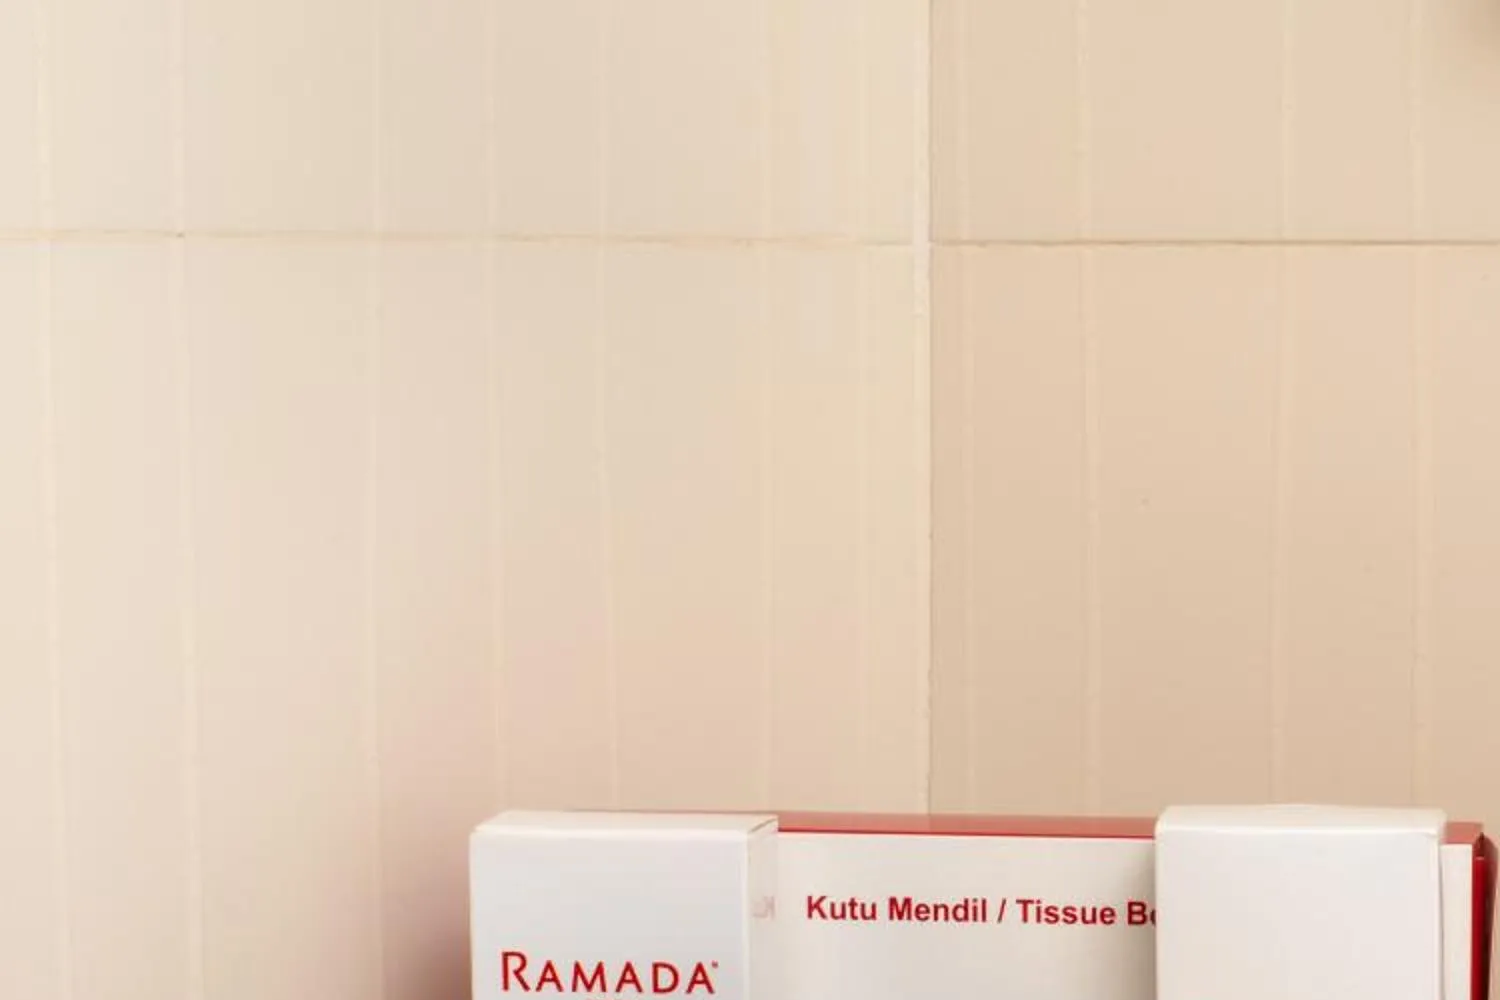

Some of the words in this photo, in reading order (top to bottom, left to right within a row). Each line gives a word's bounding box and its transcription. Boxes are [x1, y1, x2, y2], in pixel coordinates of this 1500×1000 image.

[807, 896, 877, 920] Kutu
[888, 897, 987, 922] Mendil
[997, 898, 1007, 923] /
[1016, 899, 1116, 924] Tissue
[501, 951, 716, 994] RAMADA
